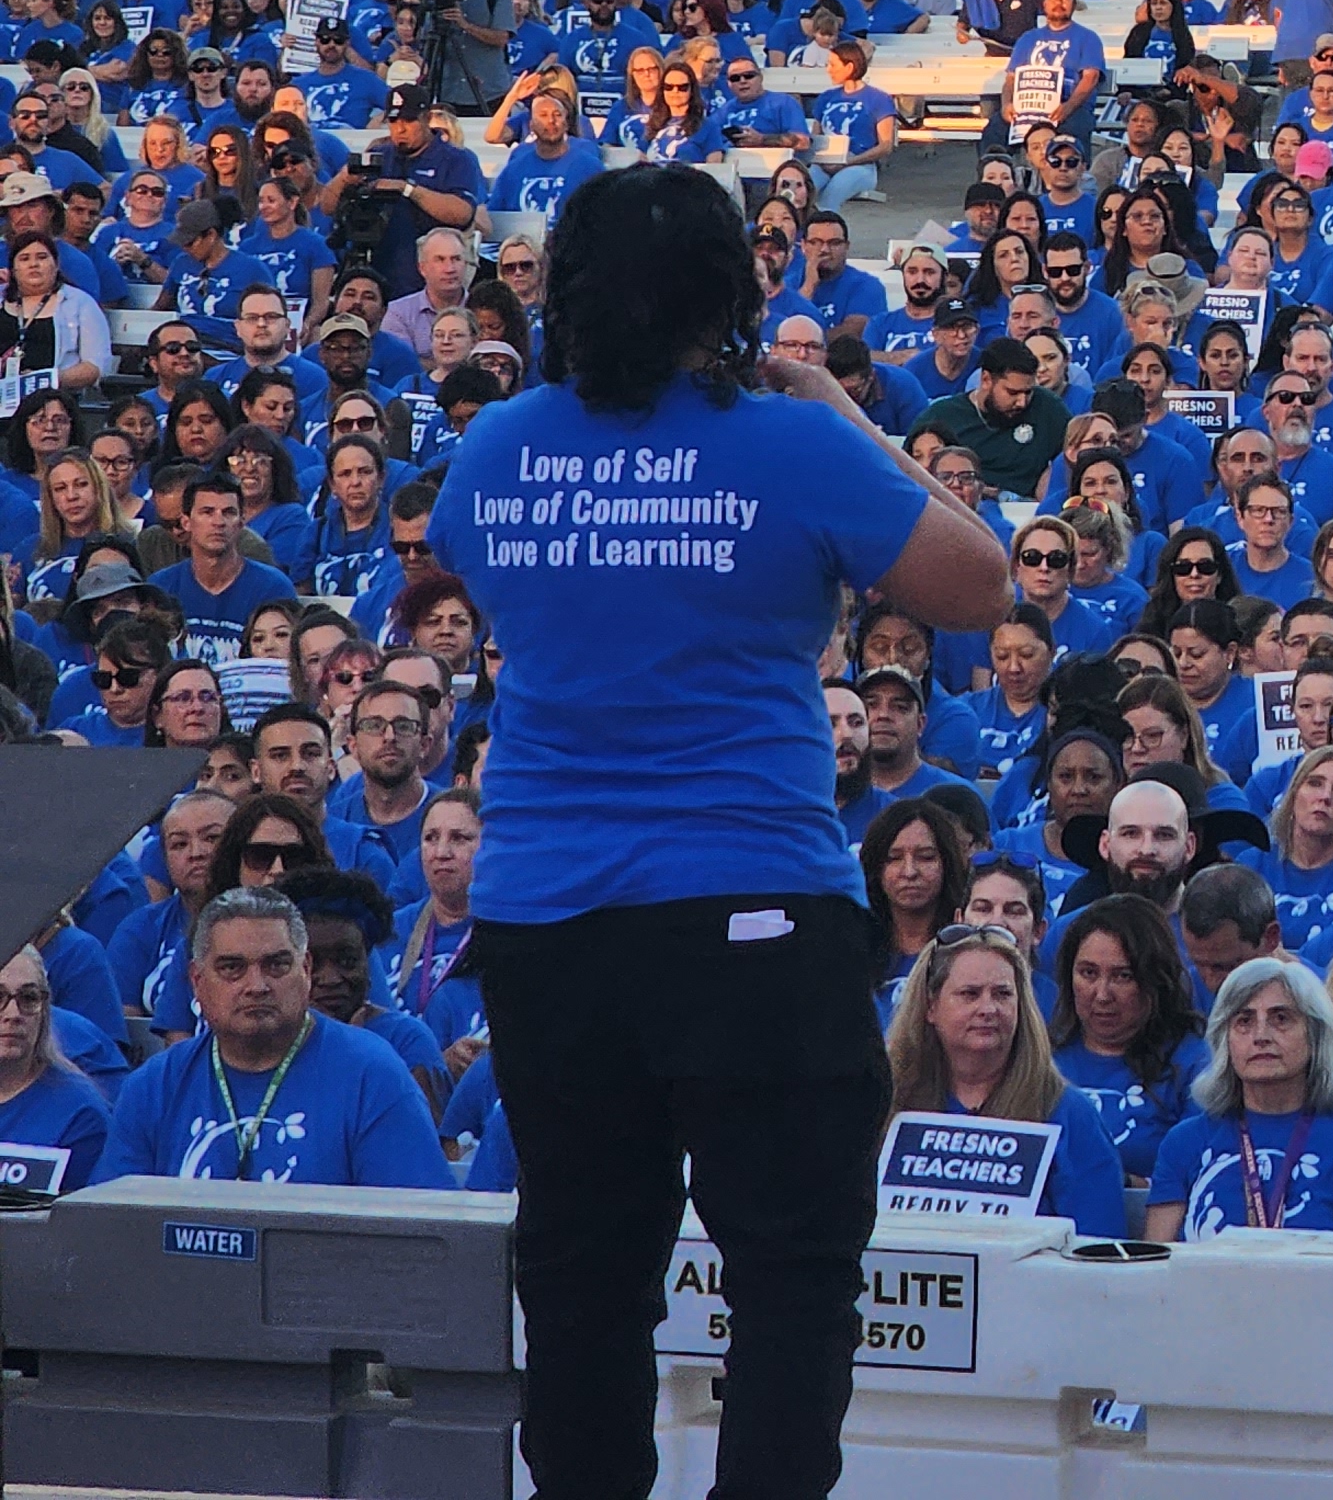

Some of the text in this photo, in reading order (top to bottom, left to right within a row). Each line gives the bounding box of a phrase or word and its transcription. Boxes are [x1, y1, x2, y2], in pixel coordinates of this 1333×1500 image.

[1205, 296, 1250, 308] FRESNO
[1168, 399, 1216, 412] FRESNO
[519, 446, 698, 484] Love of Self
[474, 490, 759, 531] Love of Community
[487, 531, 736, 573] Love of Learning
[920, 1129, 1018, 1157] FRESNO
[901, 1154, 1024, 1185] TEACHERS
[174, 1227, 243, 1255] WATER
